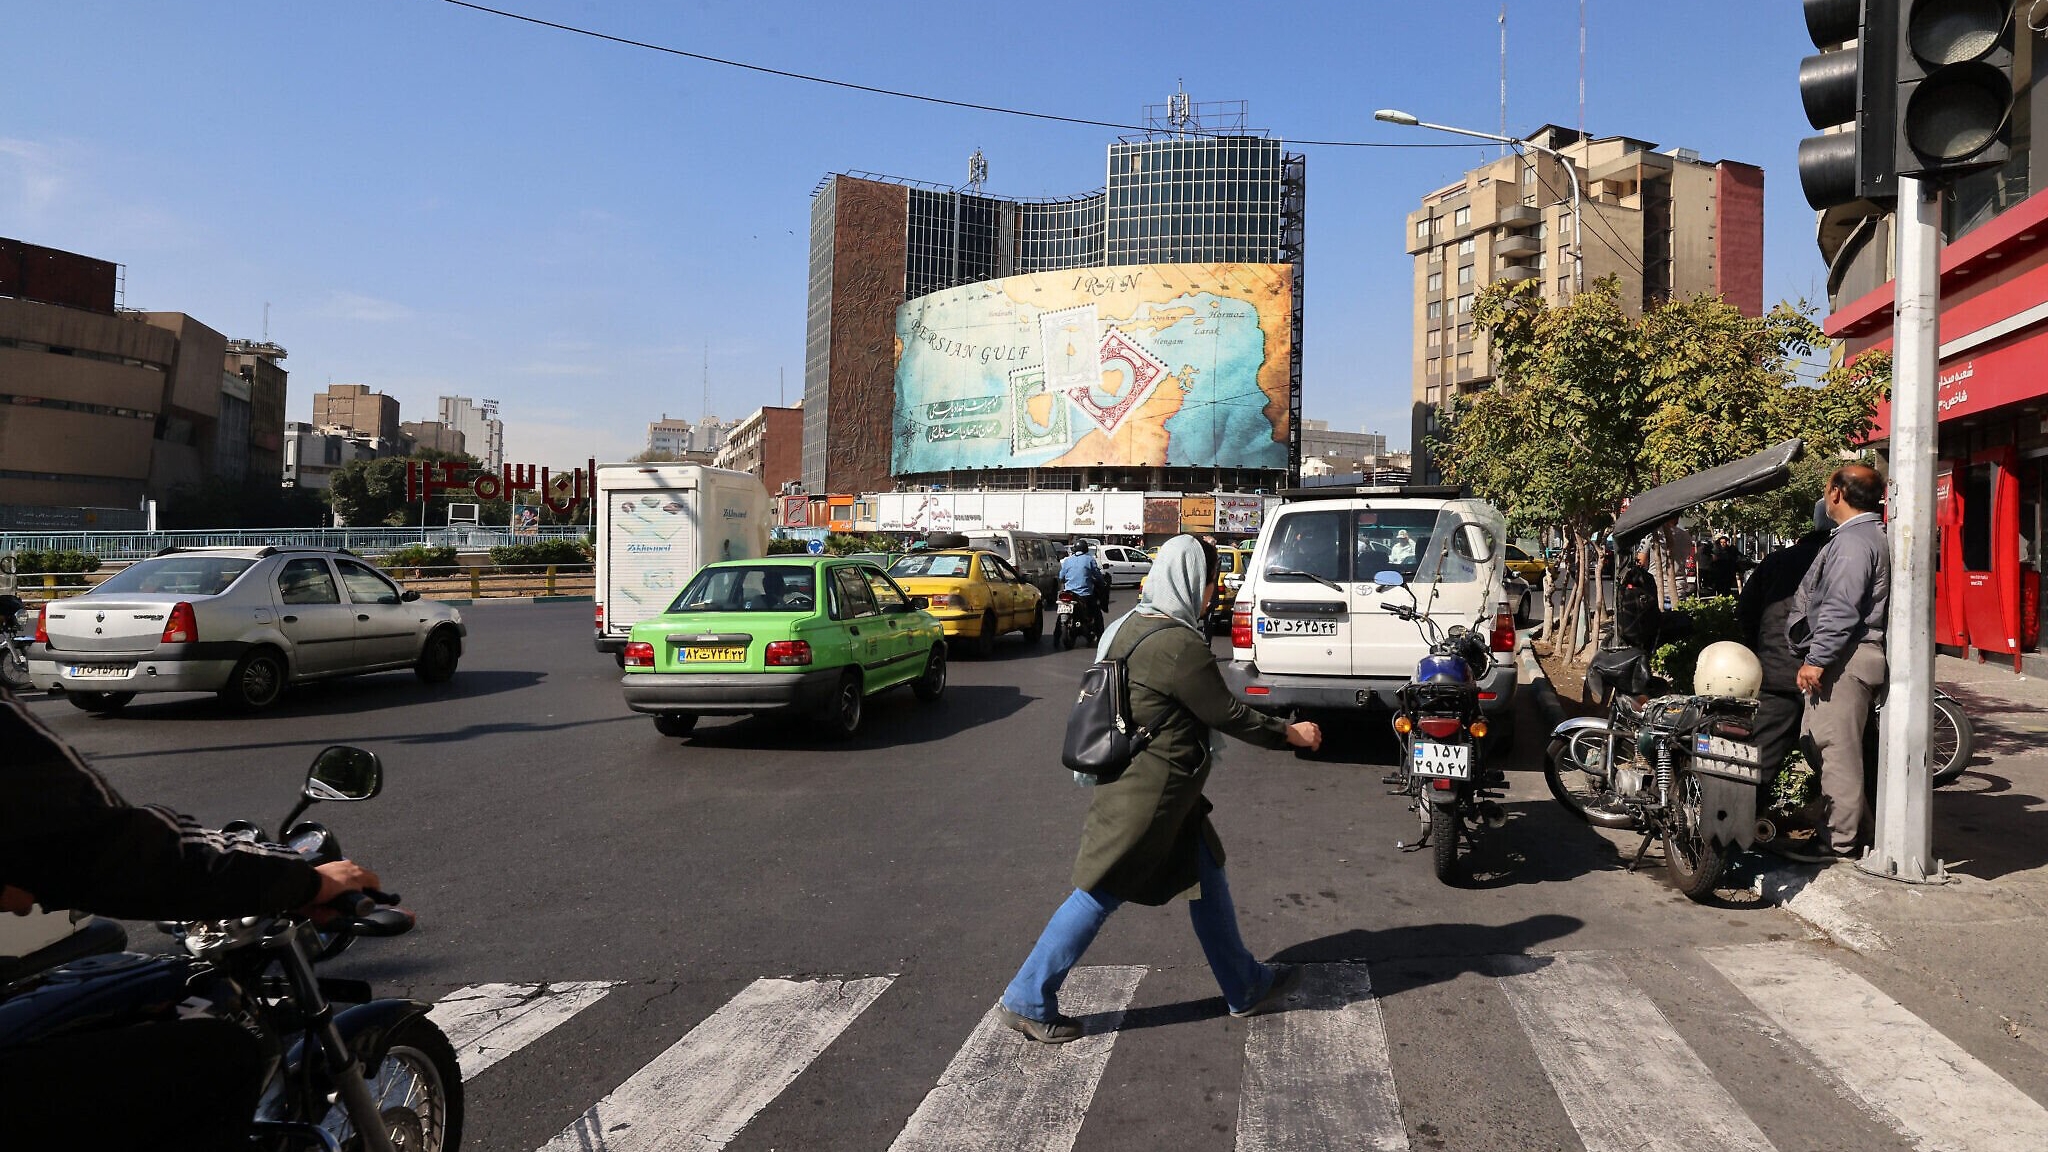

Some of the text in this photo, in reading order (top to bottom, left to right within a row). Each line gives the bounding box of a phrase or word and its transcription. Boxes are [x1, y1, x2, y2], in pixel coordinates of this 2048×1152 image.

[1072, 272, 1142, 296] IRAN
[1194, 327, 1222, 335] Larak
[911, 318, 1030, 365] PERSIAN GULF
[1153, 338, 1184, 346] Hengam
[1955, 362, 1973, 385] شعبه
[408, 459, 597, 514] ان ۱۴۰۳
[1221, 499, 1237, 508] فود
[1239, 498, 1257, 507] فست
[1229, 512, 1249, 522] آرام
[1265, 619, 1280, 632] ۵۳
[1295, 620, 1319, 633] ۶۳۵
[1433, 745, 1461, 759] ۱۵۷
[1415, 760, 1466, 776] ۲۹۵۴۷
